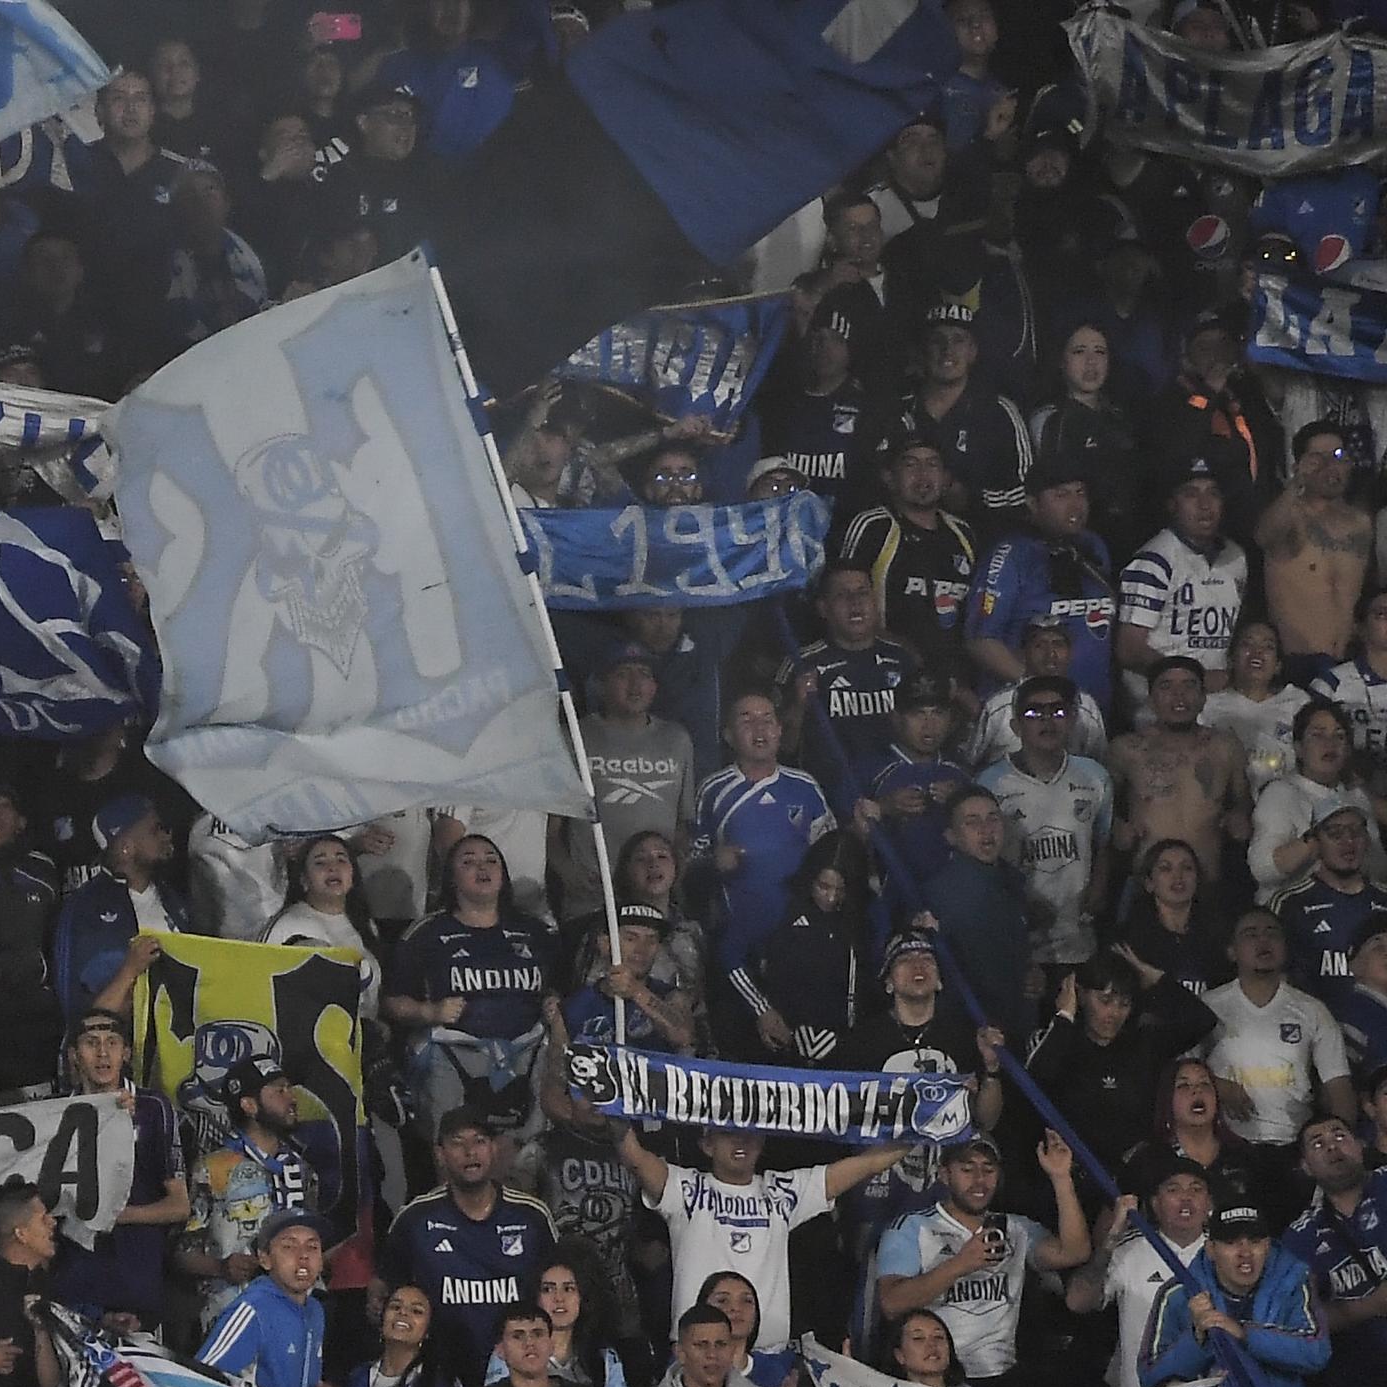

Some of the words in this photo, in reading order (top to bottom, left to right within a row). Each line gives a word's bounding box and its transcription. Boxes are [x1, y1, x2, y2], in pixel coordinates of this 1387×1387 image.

[587, 757, 677, 778] Reebok
[449, 966, 544, 993] ANDINA
[616, 1050, 658, 1116] EL
[664, 1064, 850, 1137] RECUERDO
[859, 1077, 910, 1138] Z-7
[442, 1275, 521, 1305] ANDINA
